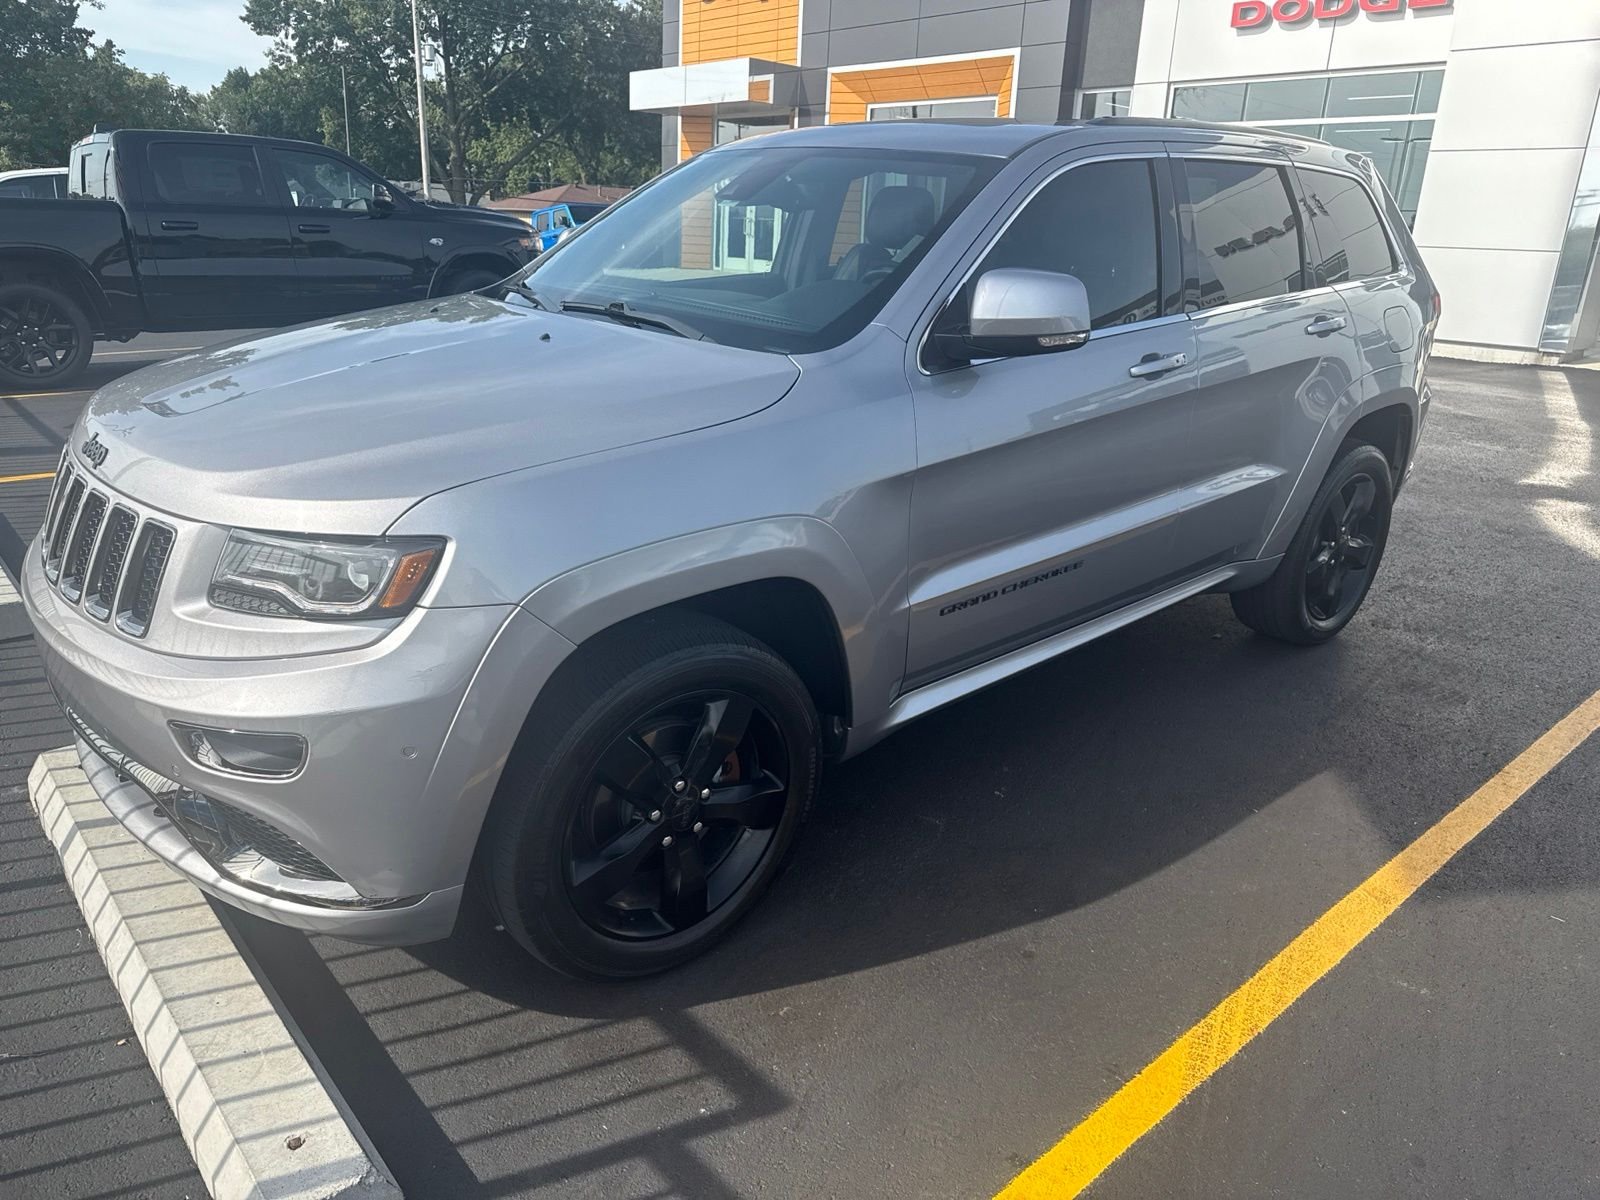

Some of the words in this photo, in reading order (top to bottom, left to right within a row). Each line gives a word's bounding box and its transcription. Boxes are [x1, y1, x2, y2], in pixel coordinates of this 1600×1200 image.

[82, 432, 109, 470] Jeep
[939, 590, 999, 617] GRAND
[1001, 560, 1085, 595] CHEROKEE
